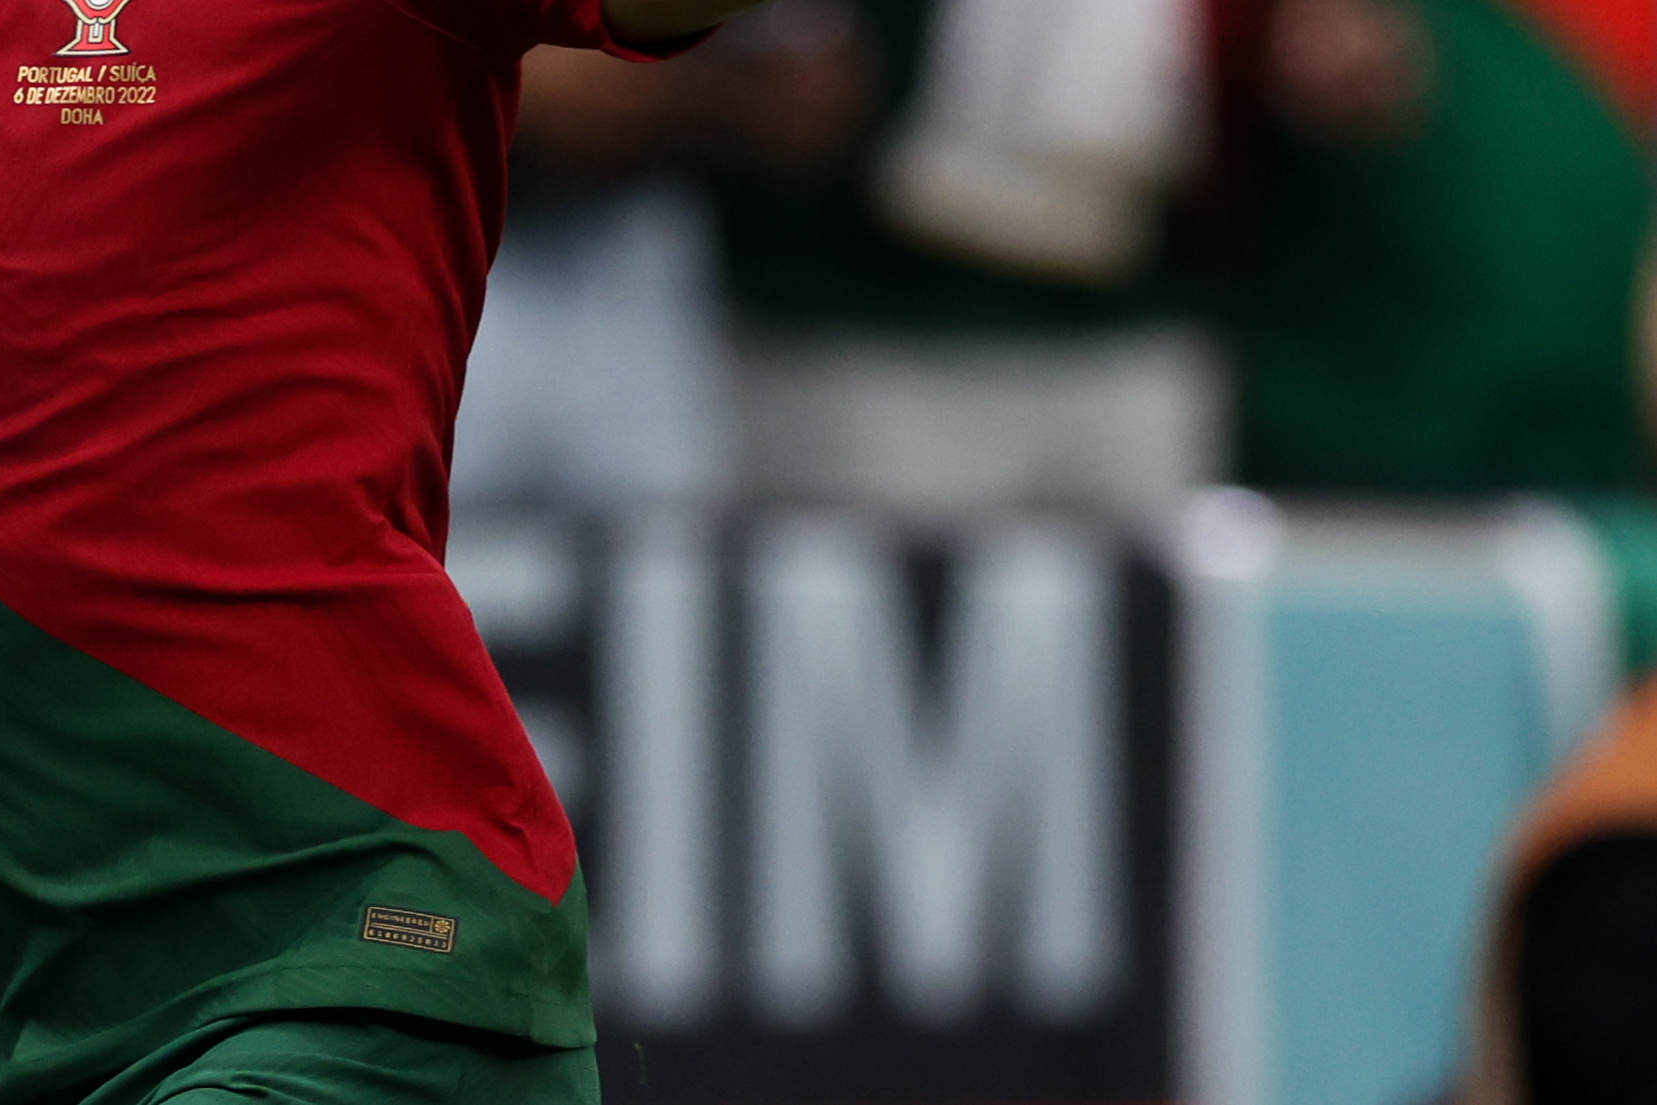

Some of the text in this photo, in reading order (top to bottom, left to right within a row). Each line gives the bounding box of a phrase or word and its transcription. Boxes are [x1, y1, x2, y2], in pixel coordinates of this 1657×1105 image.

[17, 65, 93, 84] PORTUGAL
[109, 61, 157, 84] SUÍÇA
[13, 85, 156, 105] 6 DE DEZEMBRO 2022
[60, 107, 104, 126] DOHA
